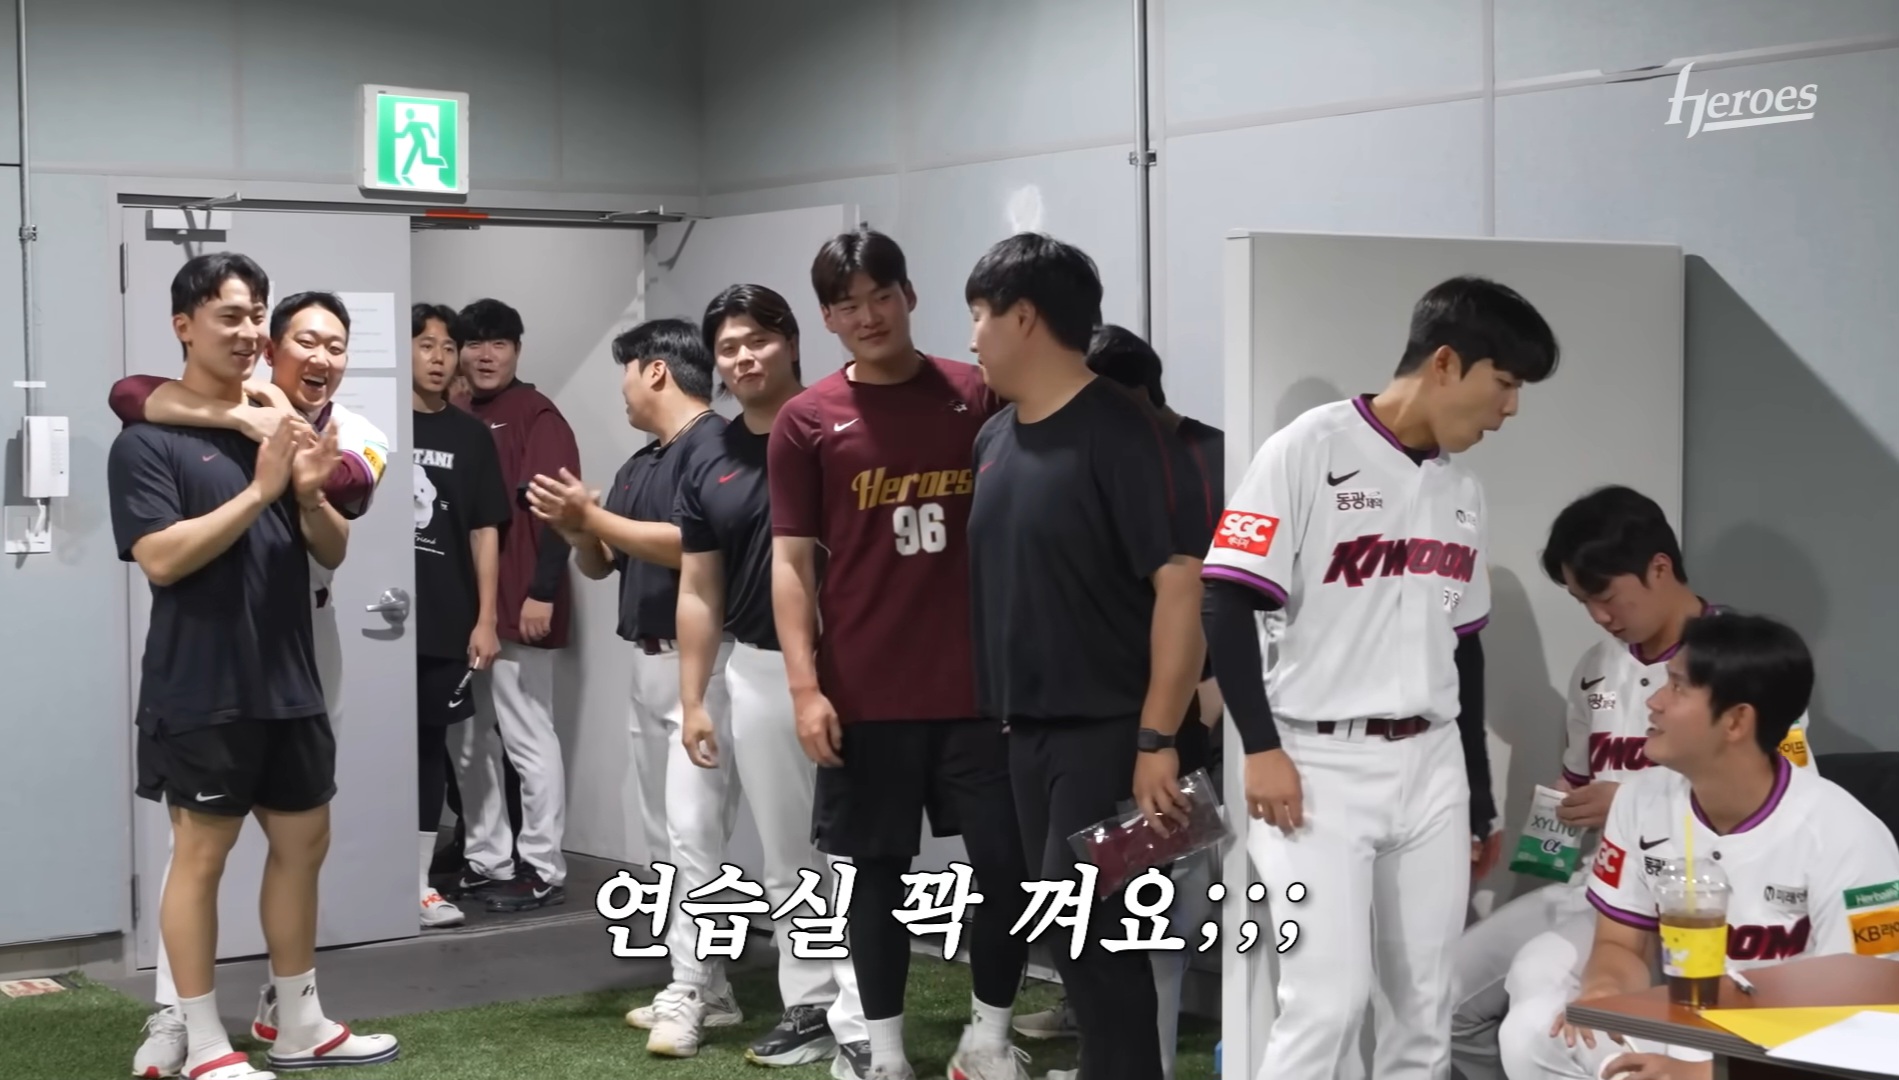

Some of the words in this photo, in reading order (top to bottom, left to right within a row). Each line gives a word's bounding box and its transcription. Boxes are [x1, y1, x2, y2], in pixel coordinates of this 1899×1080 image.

[851, 466, 973, 511] Heroes
[892, 502, 947, 556] 96
[1219, 513, 1272, 542] SGC
